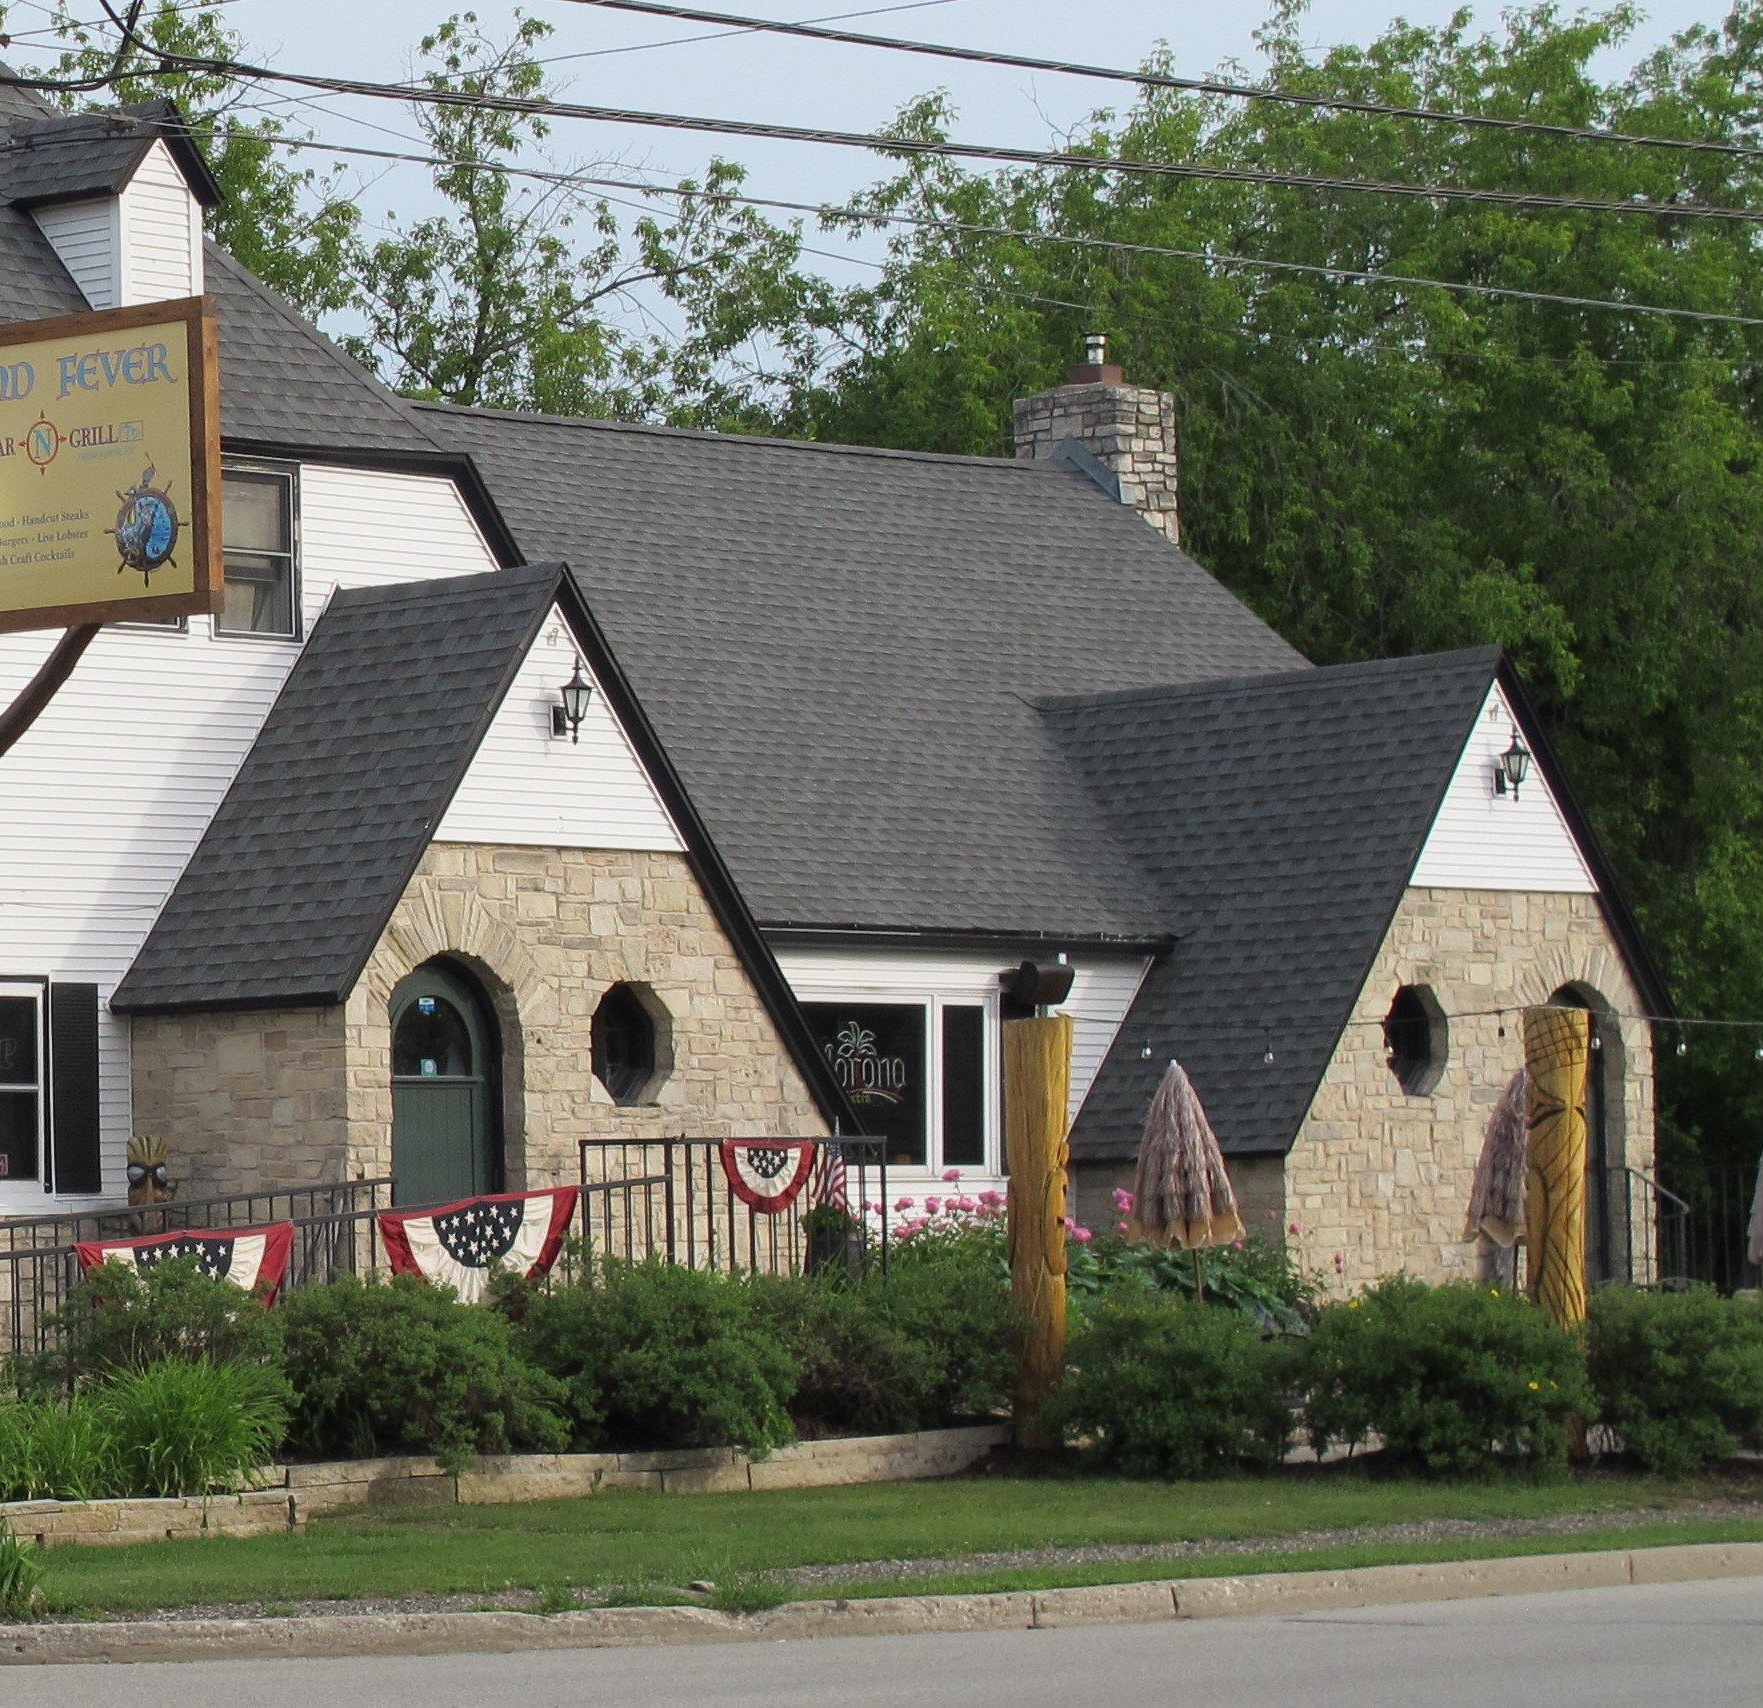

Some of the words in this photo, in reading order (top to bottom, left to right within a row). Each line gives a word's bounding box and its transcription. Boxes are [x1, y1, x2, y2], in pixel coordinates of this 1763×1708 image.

[56, 342, 178, 400] FEVER
[33, 428, 52, 458] N
[69, 424, 118, 448] GRILL
[61, 509, 90, 521] Steaks
[37, 532, 54, 543] Live
[56, 528, 89, 541] Lobster
[10, 554, 33, 566] Craft
[34, 549, 75, 563] Cocktails
[825, 1044, 906, 1088] orona
